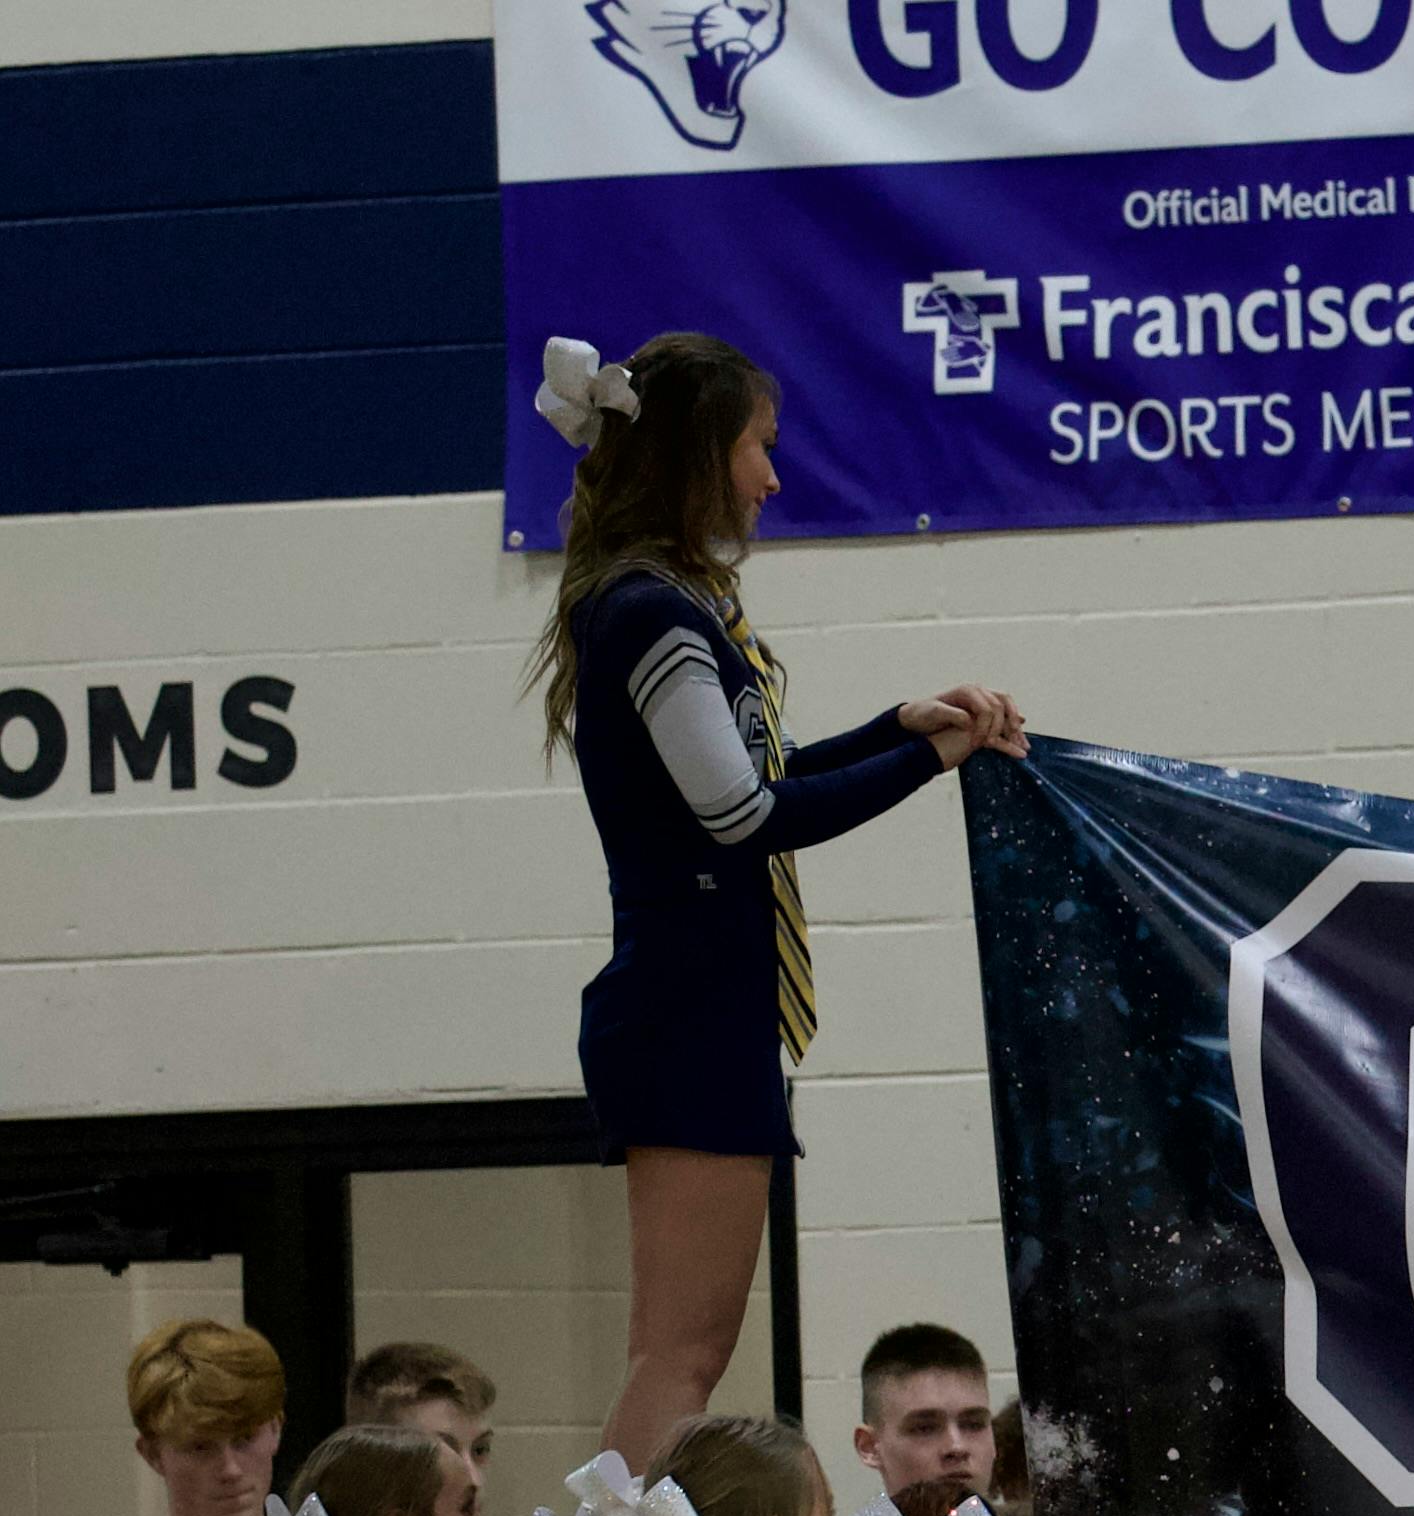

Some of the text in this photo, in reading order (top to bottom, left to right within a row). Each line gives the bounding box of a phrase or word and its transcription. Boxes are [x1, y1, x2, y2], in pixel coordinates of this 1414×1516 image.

[1123, 185, 1250, 229] Official
[1259, 176, 1397, 223] Medical
[1048, 392, 1297, 465] SPORTS
